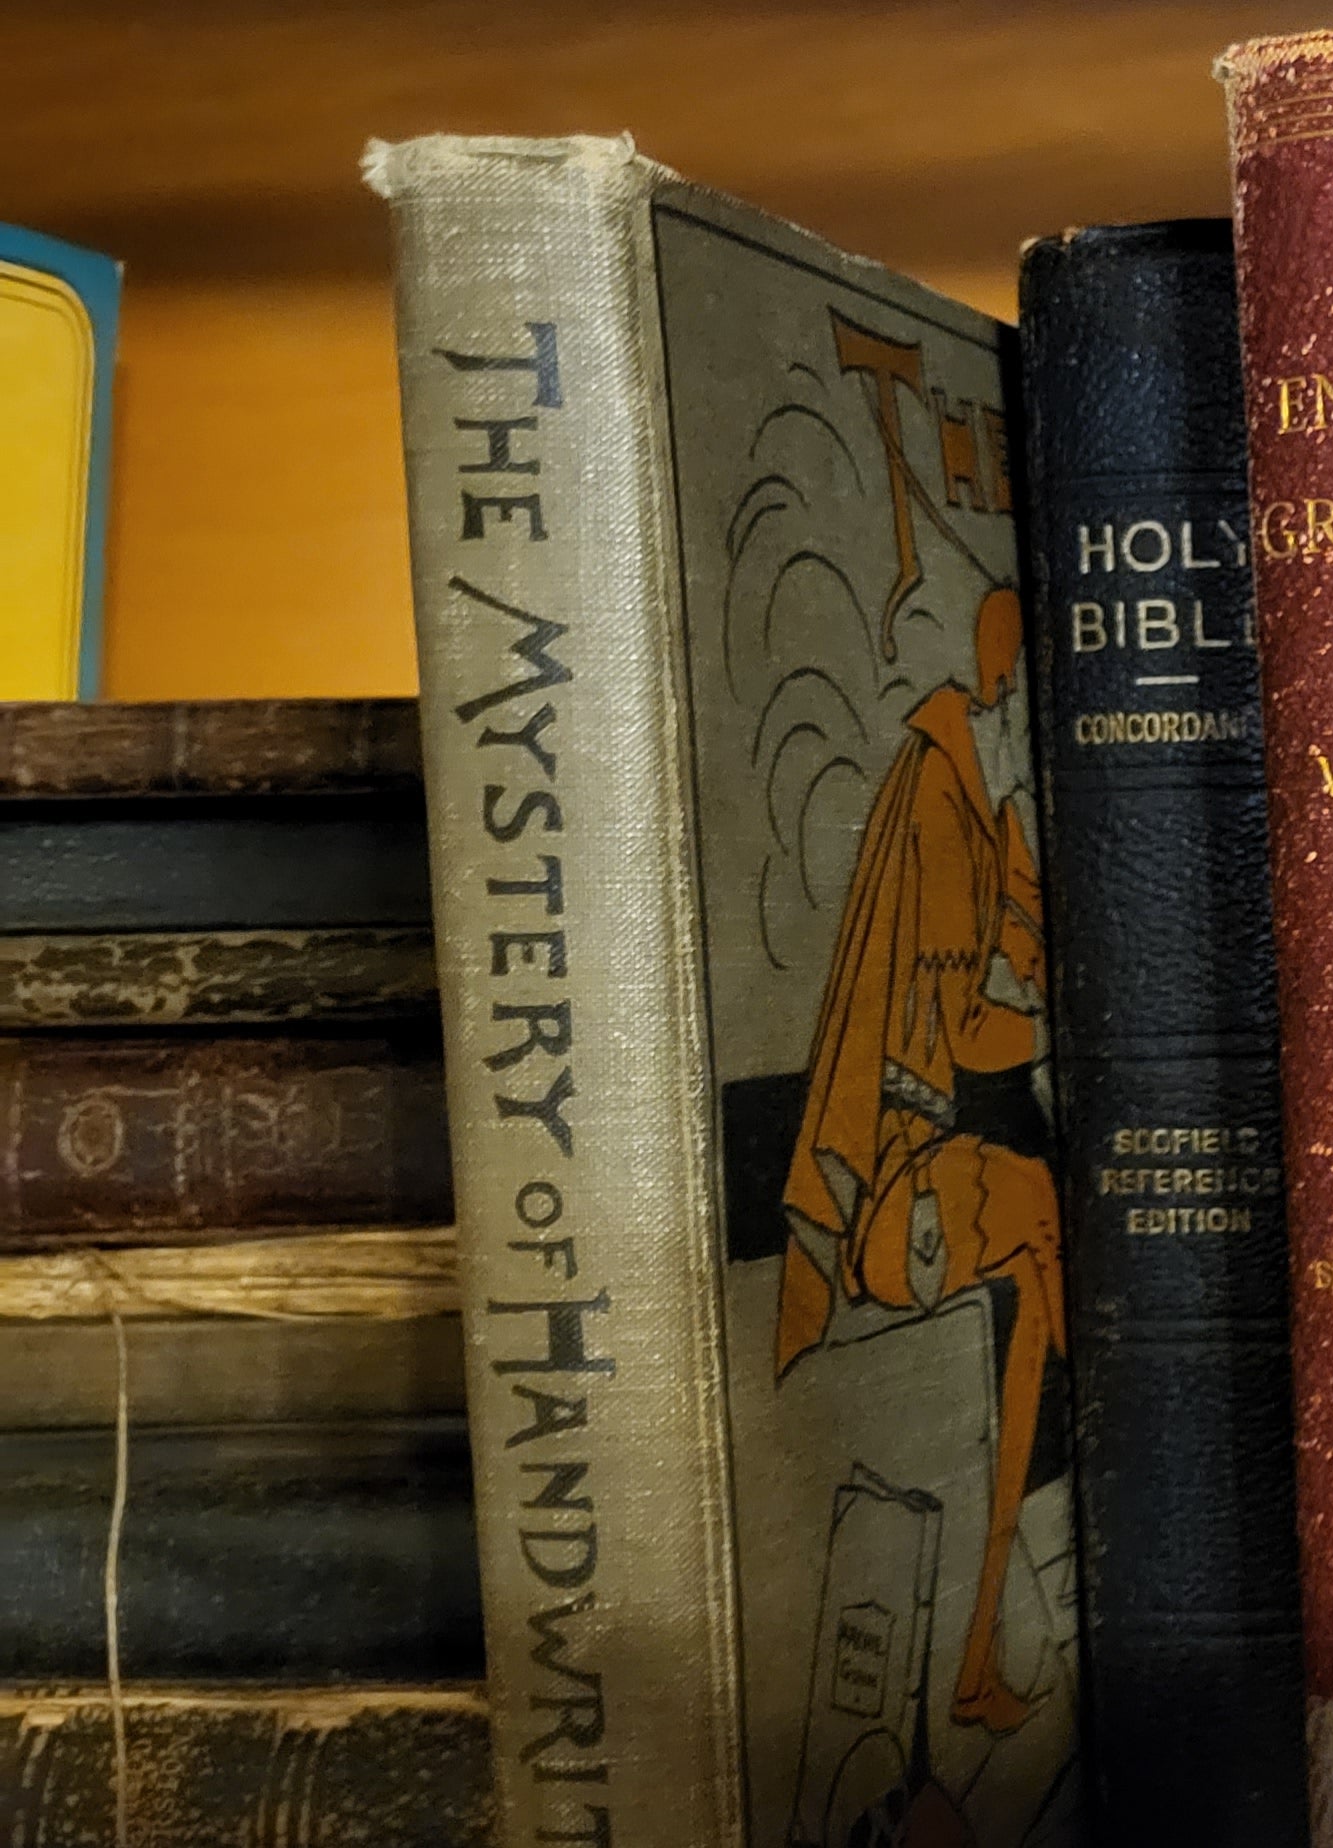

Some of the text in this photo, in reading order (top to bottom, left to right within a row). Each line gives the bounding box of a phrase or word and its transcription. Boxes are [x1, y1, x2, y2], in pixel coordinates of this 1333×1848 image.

[431, 321, 564, 542] THE
[1077, 518, 1248, 576] HOLY
[447, 574, 576, 1160] MYSTERY
[507, 1180, 578, 1281] OF
[1126, 1206, 1250, 1235] EDITION
